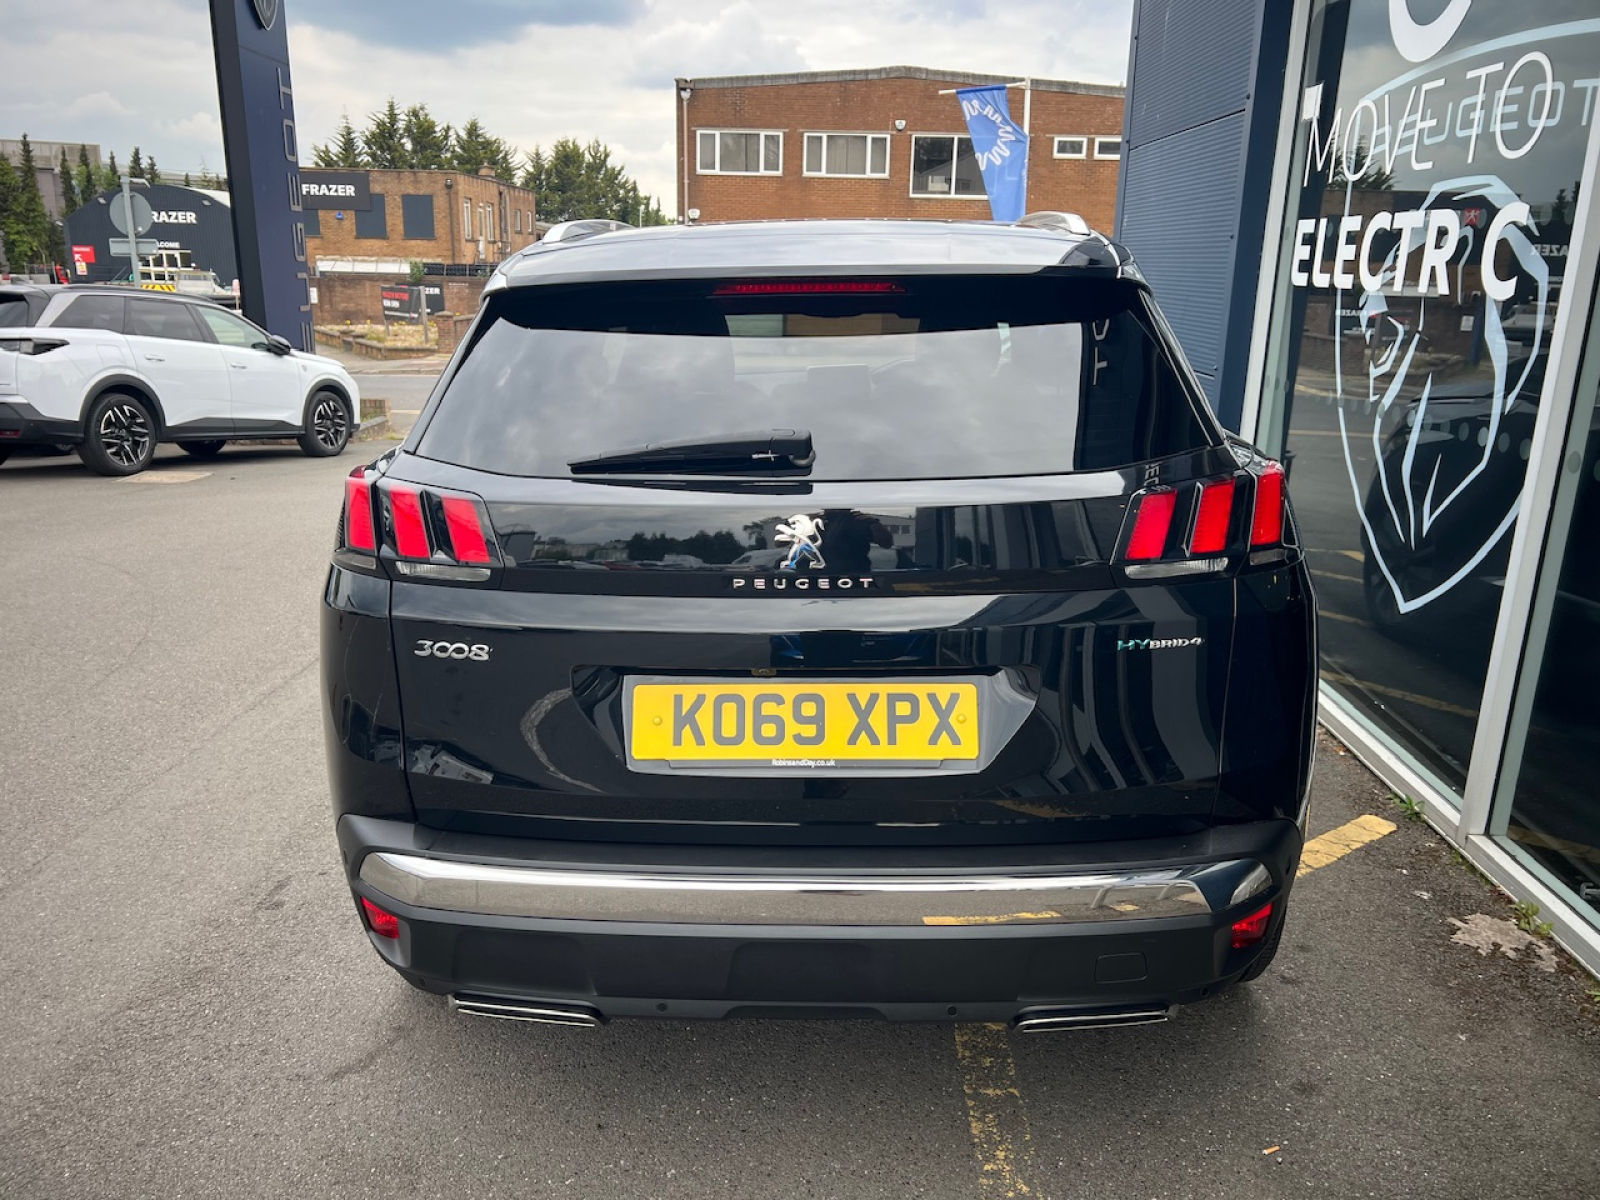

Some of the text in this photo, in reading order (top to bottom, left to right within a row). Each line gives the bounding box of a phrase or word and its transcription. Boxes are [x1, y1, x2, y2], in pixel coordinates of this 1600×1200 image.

[1303, 50, 1554, 187] MOVE TO
[301, 183, 356, 196] FRAZER
[151, 210, 197, 223] RAZER
[276, 67, 315, 352] EUGEOT
[733, 578, 874, 589] PEUGEOT
[414, 640, 490, 661] 3008
[1117, 637, 1202, 651] HYBRID4
[672, 692, 962, 747] KO69 XPX
